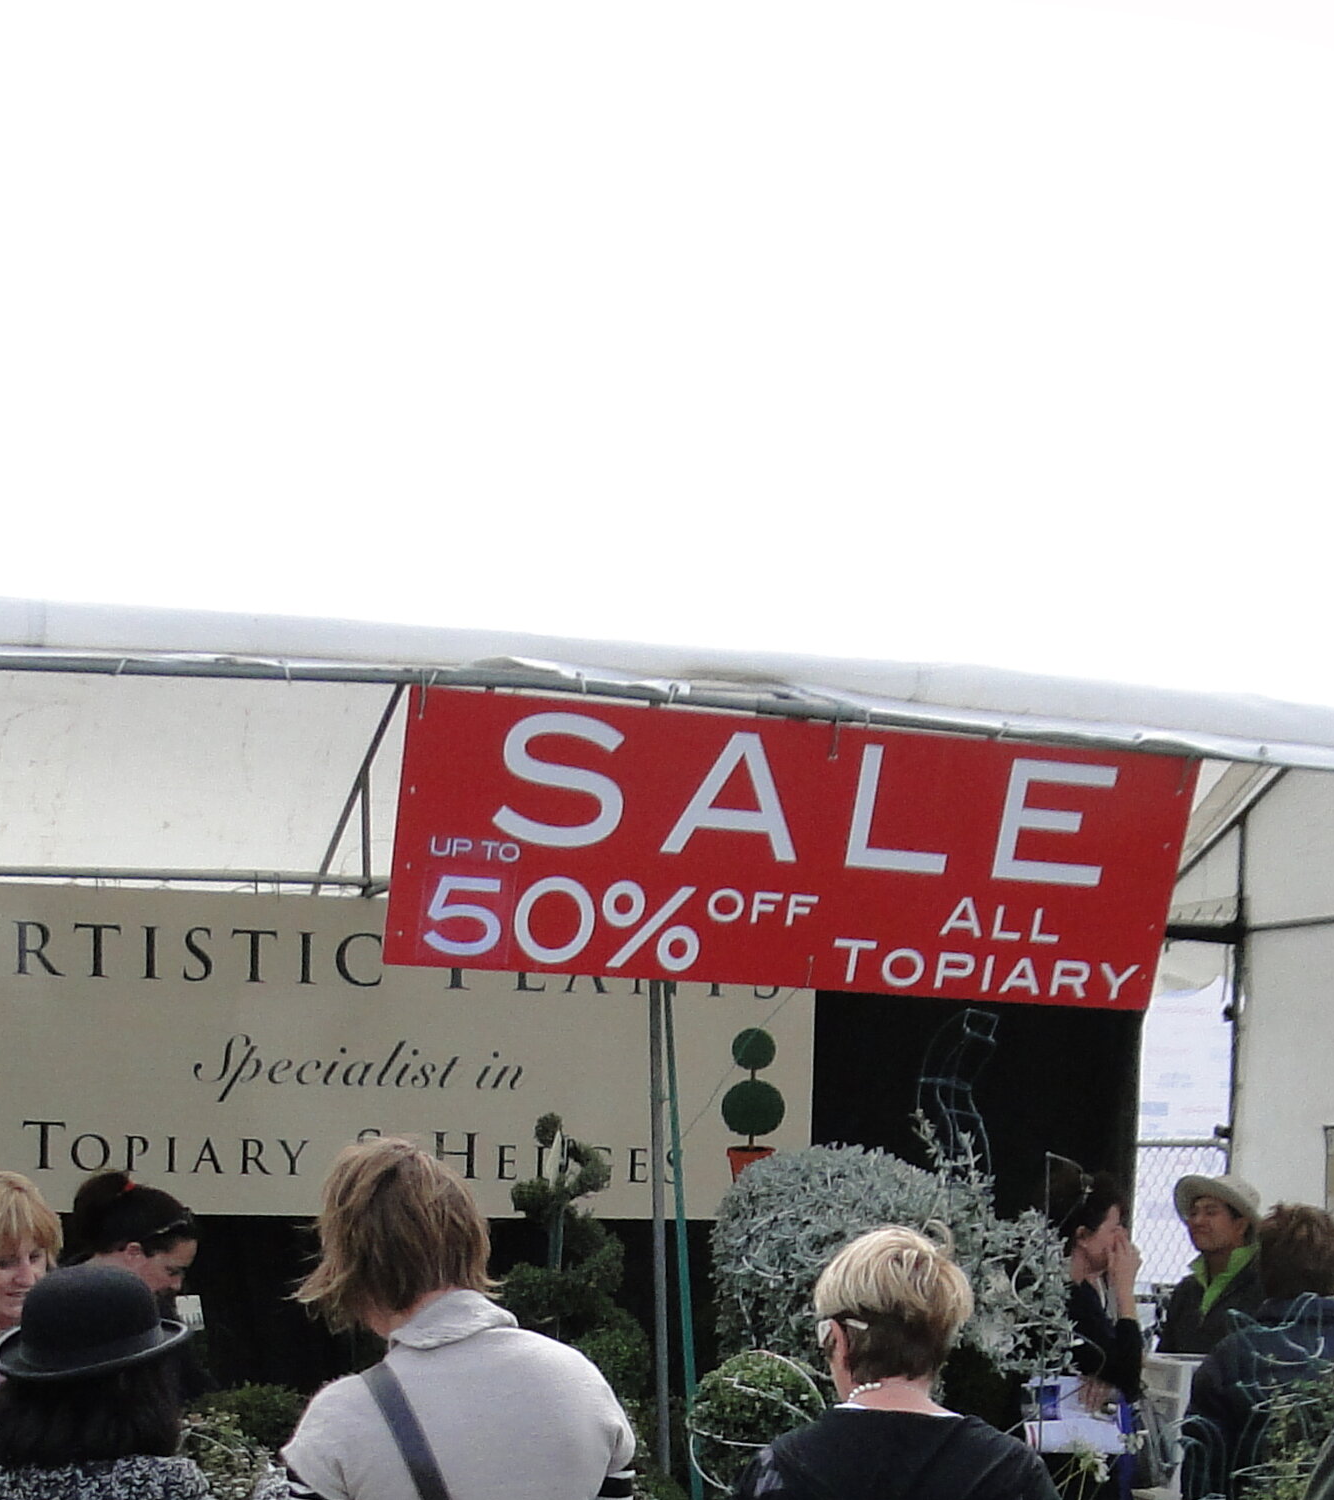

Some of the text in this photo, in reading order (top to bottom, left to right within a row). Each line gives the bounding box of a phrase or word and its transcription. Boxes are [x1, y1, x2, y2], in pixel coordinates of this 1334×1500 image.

[491, 711, 1120, 888] SALE
[430, 836, 520, 863] UP TO
[423, 875, 819, 972] 50% OFF
[939, 896, 1060, 944] ALL
[833, 937, 1140, 1001] TOPIARY
[194, 1033, 524, 1103] Specialist in
[22, 1119, 310, 1176] TOPIARY
